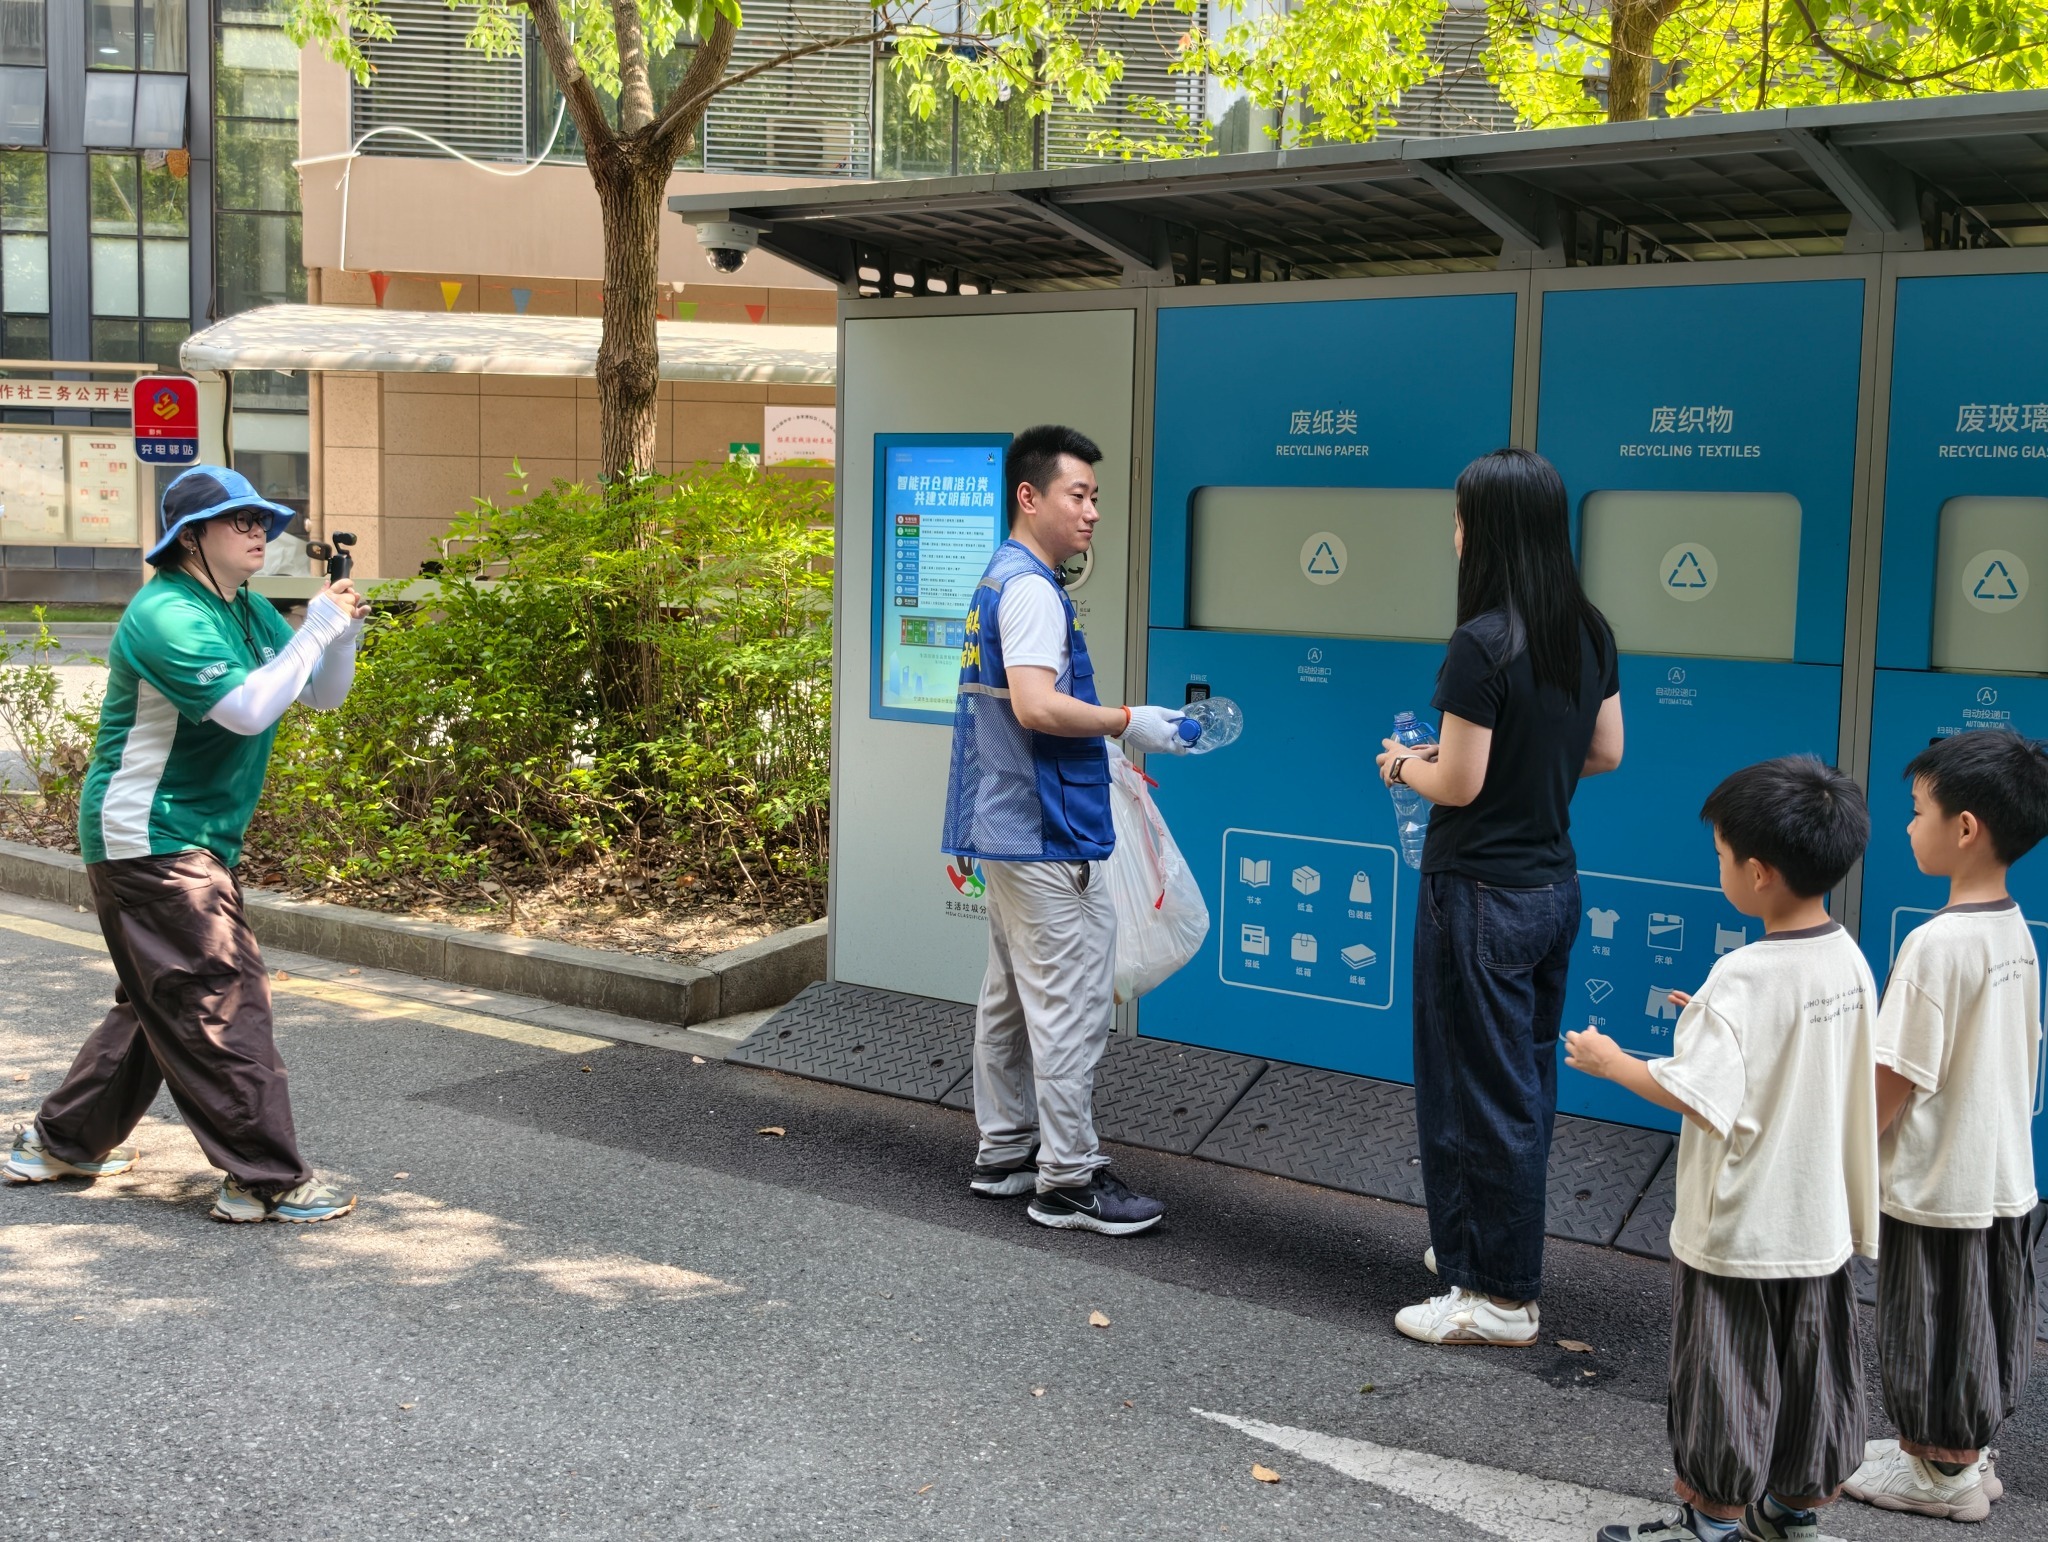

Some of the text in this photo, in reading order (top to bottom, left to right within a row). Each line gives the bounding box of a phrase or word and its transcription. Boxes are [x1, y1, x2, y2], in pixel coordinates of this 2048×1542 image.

[0, 384, 129, 402] 作社三务公开栏
[1289, 409, 1357, 435] 废纸类
[1650, 405, 1734, 433] 废织物
[1956, 403, 2048, 433] 废玻璃
[141, 444, 194, 456] 充电驿站
[1276, 445, 1369, 456] RECYCLING PAPER
[1620, 445, 1761, 457] RECYCLING TEXTILES
[1939, 445, 2048, 458] RECYCLING GLA
[897, 475, 989, 492] 智能开仓精准分类
[914, 491, 994, 507] 共建文明新风尚
[1962, 708, 2010, 720] 自动投递口
[1246, 896, 1262, 905] 书本
[945, 900, 987, 914] 生活垃圾分
[1297, 903, 1313, 913] 纸盒
[1347, 909, 1373, 920] 包装纸
[1592, 945, 1611, 956] 衣服
[1244, 959, 1260, 969] 报纸
[1654, 955, 1673, 965] 床单
[1295, 966, 1312, 977] 纸箱
[1349, 975, 1366, 985] 纸板
[1588, 1014, 1606, 1027] 围巾
[1650, 1025, 1669, 1036] 裤子
